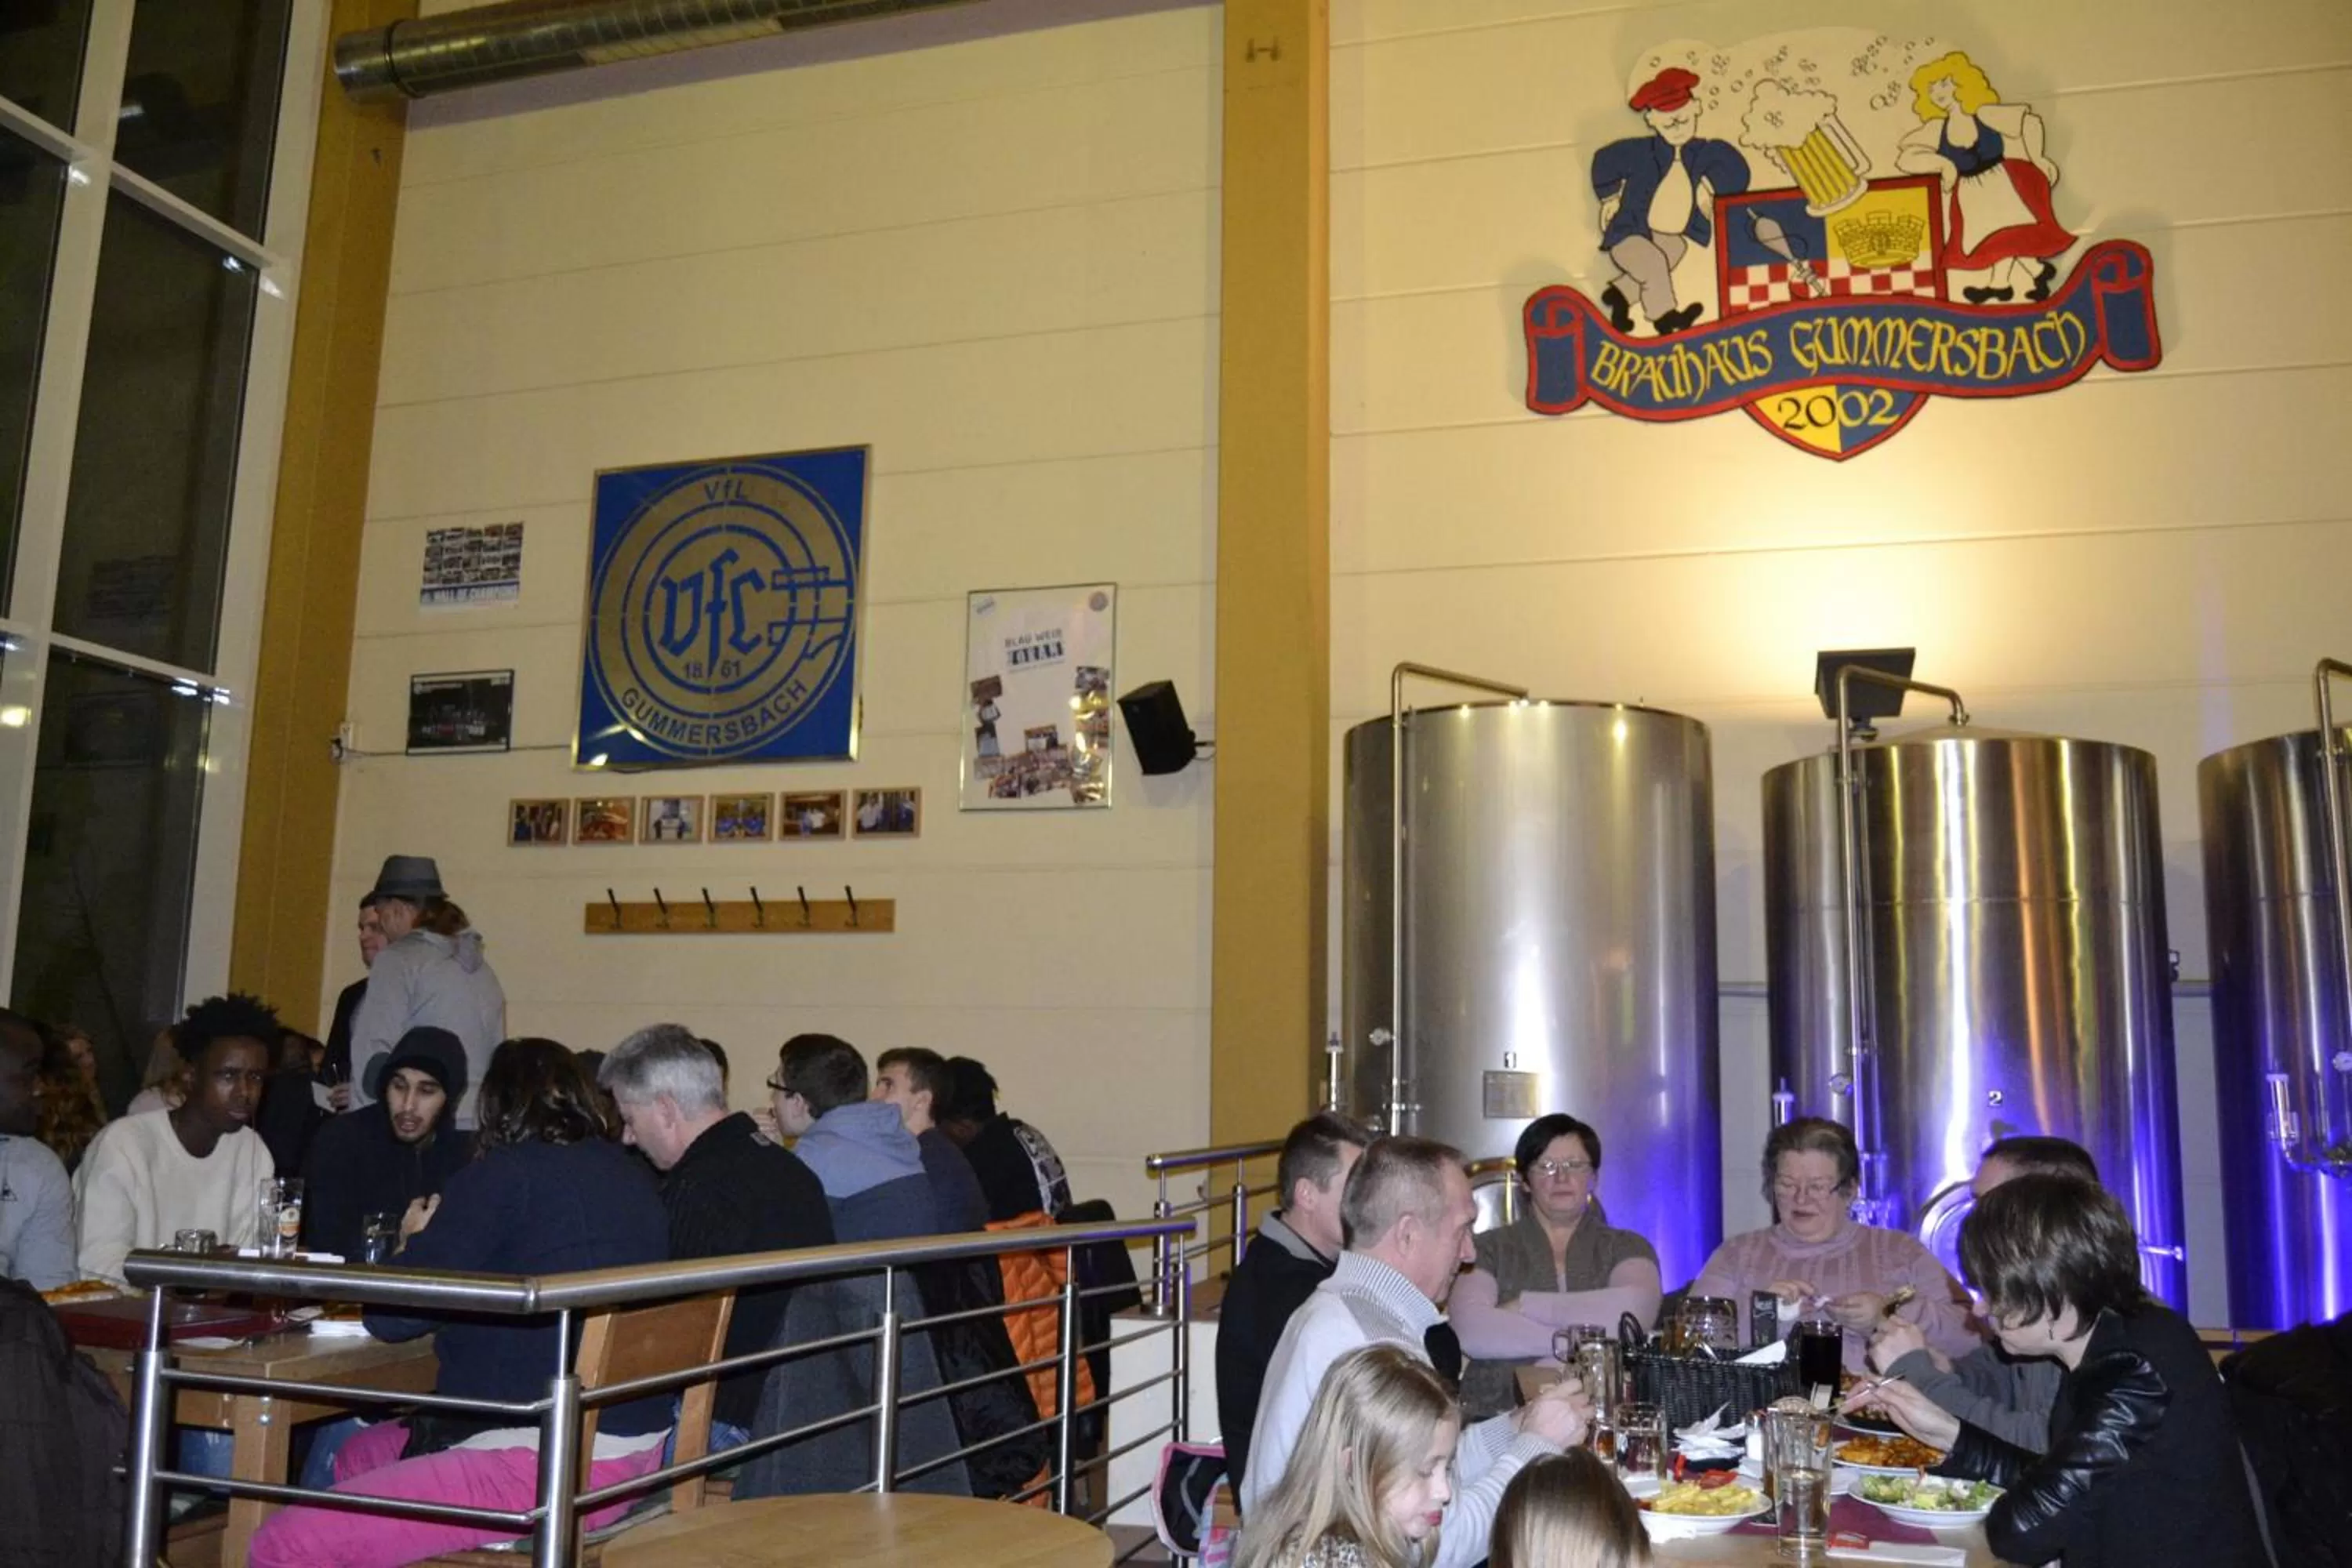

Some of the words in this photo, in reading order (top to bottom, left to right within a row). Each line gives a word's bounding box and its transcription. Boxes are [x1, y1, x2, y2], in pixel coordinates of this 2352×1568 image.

[1780, 387, 1900, 431] 2002
[705, 481, 747, 502] VfL
[622, 681, 808, 745] GUMMERSBACH
[1988, 1090, 2002, 1106] 2
